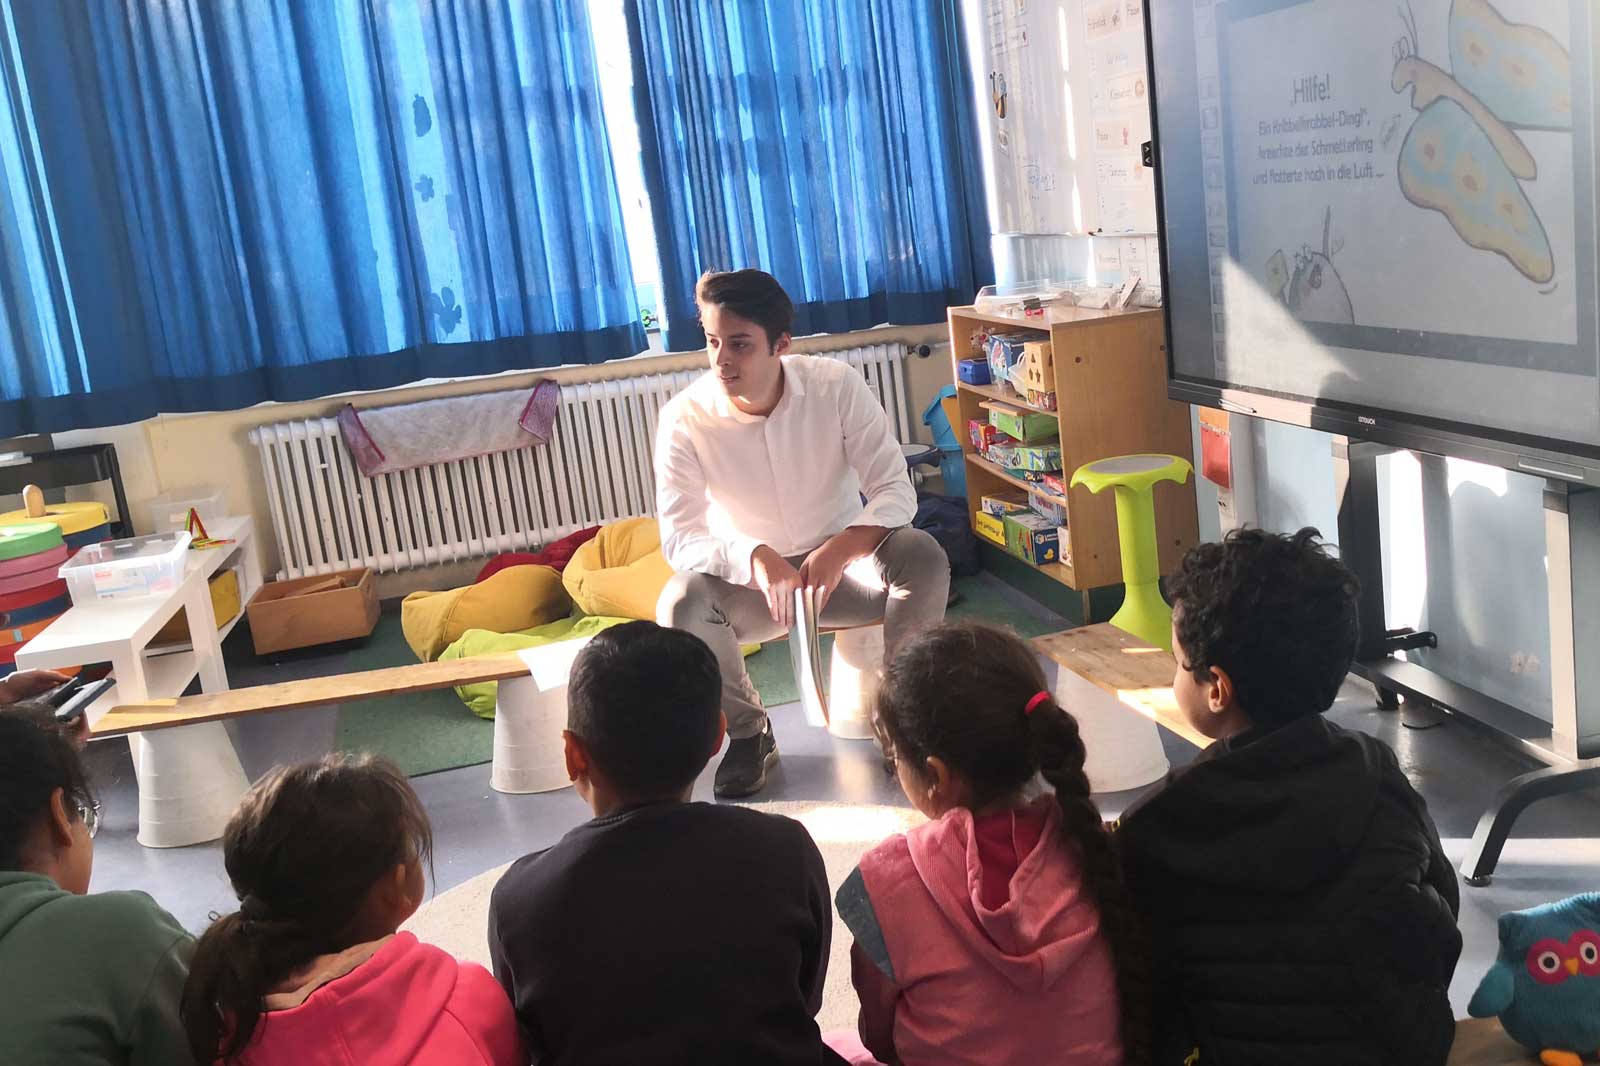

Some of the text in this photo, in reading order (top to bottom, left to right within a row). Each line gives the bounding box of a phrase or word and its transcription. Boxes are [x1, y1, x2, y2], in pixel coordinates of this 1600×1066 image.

[1311, 137, 1373, 155] Schmetterling
[1253, 169, 1268, 184] und
[1327, 165, 1336, 180] in
[1337, 164, 1352, 179] die
[1354, 162, 1373, 178] Luft
